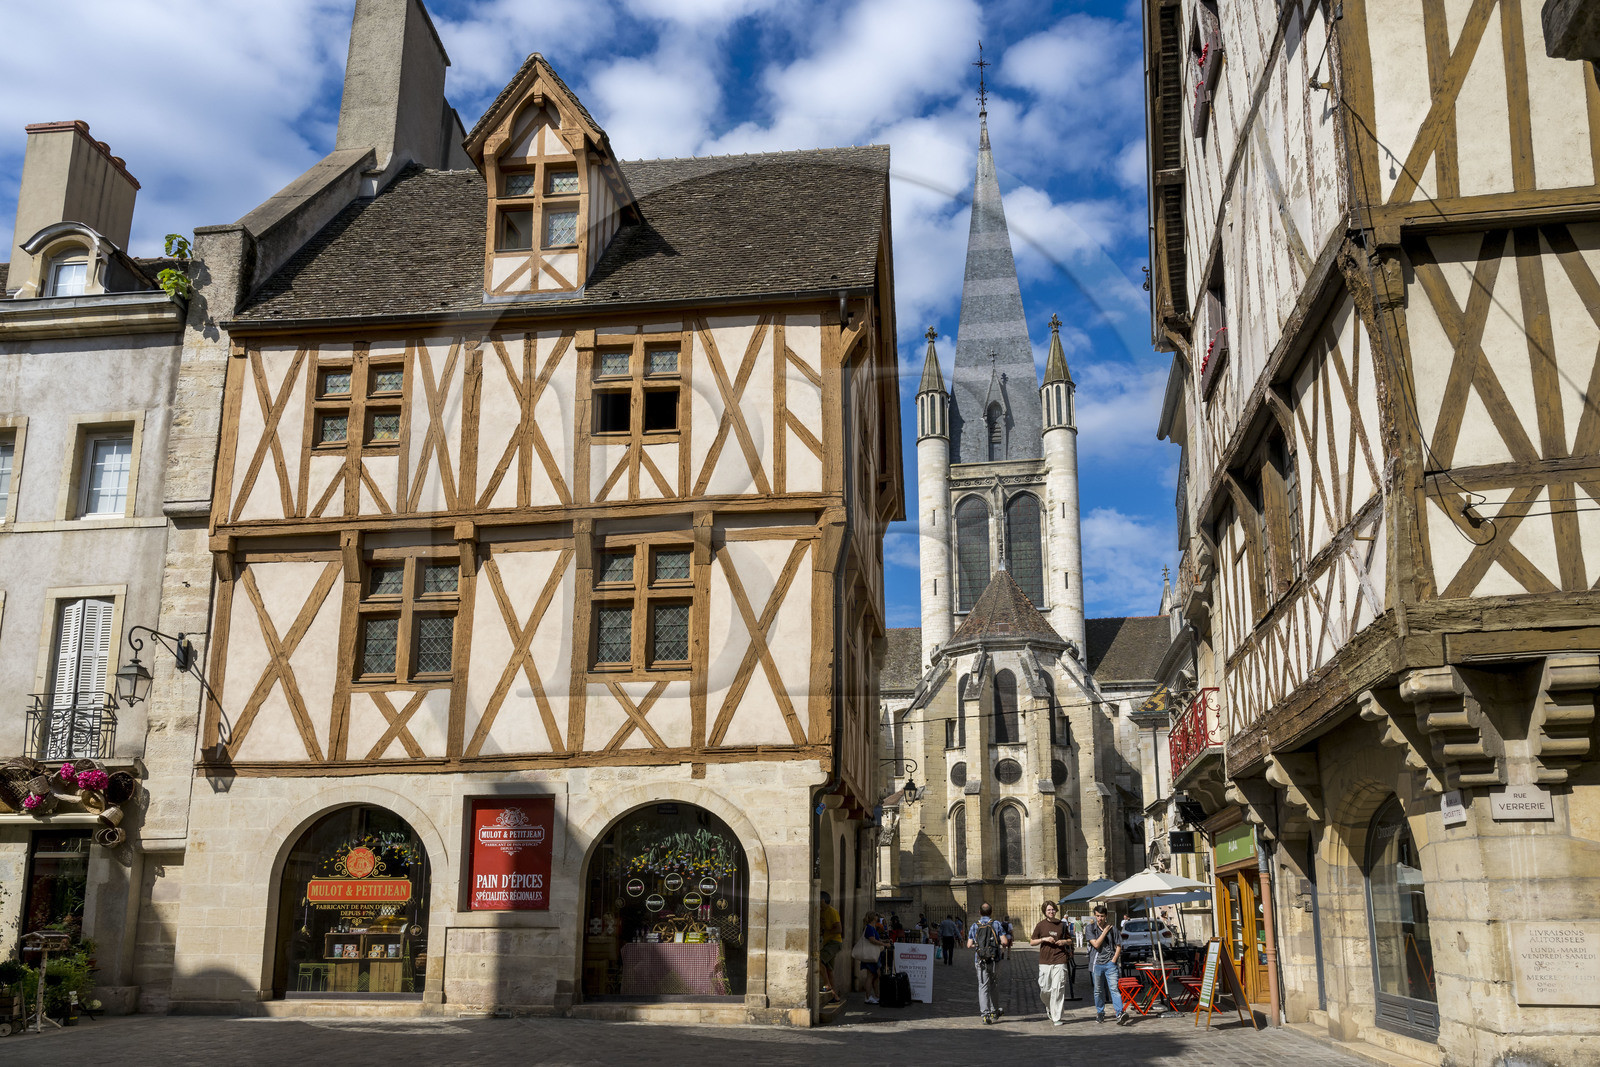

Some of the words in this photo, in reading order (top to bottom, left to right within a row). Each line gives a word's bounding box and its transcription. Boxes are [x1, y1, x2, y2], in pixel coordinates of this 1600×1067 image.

[1499, 802, 1545, 810] VERRERIE
[476, 874, 498, 888] PAIN
[502, 872, 543, 888] D'ÉPICES
[311, 884, 344, 896] MULOT
[346, 884, 353, 896] &
[356, 884, 407, 896] PETITJEAN
[476, 890, 509, 900] SPÉCIALITÉS
[510, 890, 542, 900] RÉGIONALES
